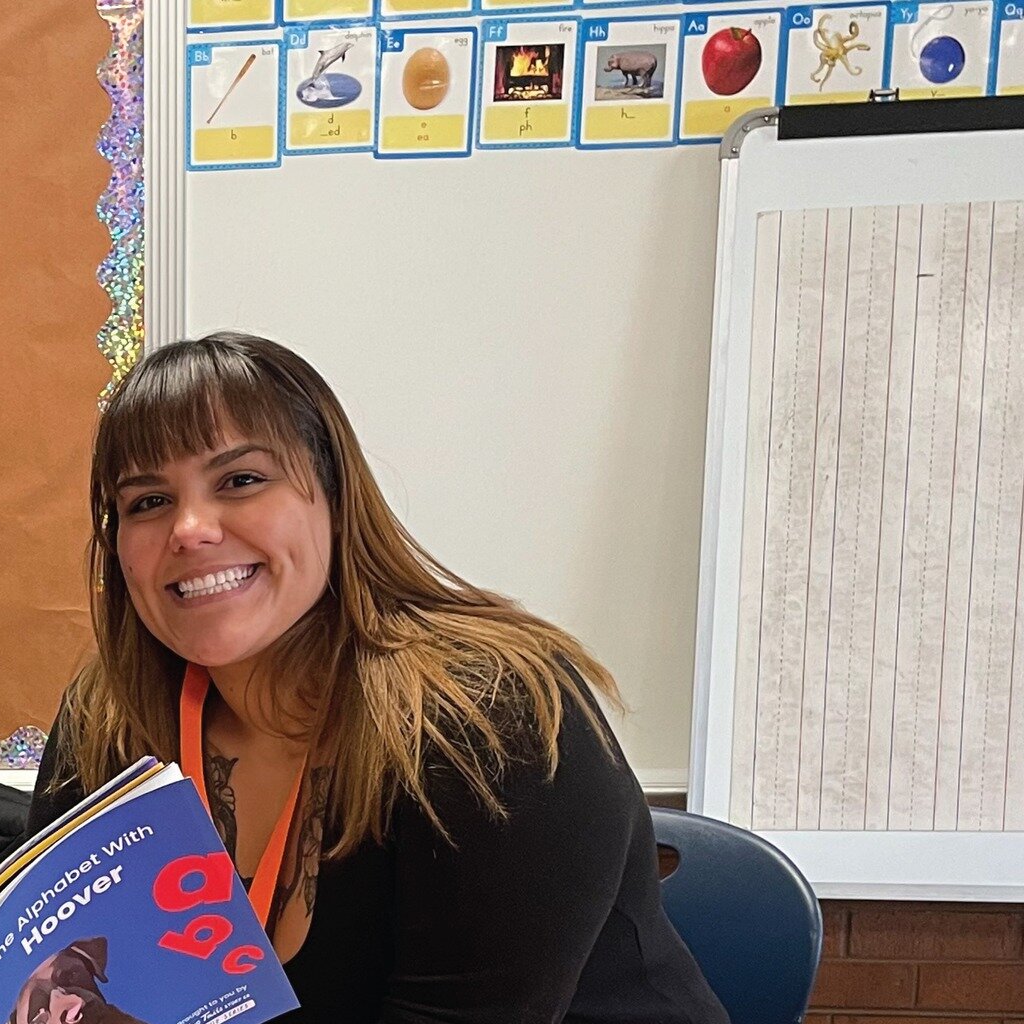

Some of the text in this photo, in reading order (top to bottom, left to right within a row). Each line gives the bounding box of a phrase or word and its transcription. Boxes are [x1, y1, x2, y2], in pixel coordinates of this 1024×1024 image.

[792, 12, 811, 26] Oo
[900, 8, 913, 22] Yy
[558, 24, 573, 33] fire
[653, 23, 675, 34] hippo
[687, 20, 705, 32] Aa
[488, 27, 504, 39] Ff
[589, 27, 606, 38] Hh
[289, 34, 306, 46] Dd
[454, 37, 468, 47] egg
[194, 51, 209, 63] Bb
[328, 113, 334, 124] d
[524, 107, 531, 118] f
[519, 120, 533, 136] ph
[230, 129, 237, 140] b
[16, 853, 102, 932] Alphabet
[102, 823, 155, 857] With
[152, 851, 236, 913] a
[19, 864, 125, 956] Hoover
[156, 914, 234, 960] b
[221, 944, 265, 975] c
[208, 998, 219, 1007] to
[219, 990, 235, 1003] you
[235, 984, 247, 993] by
